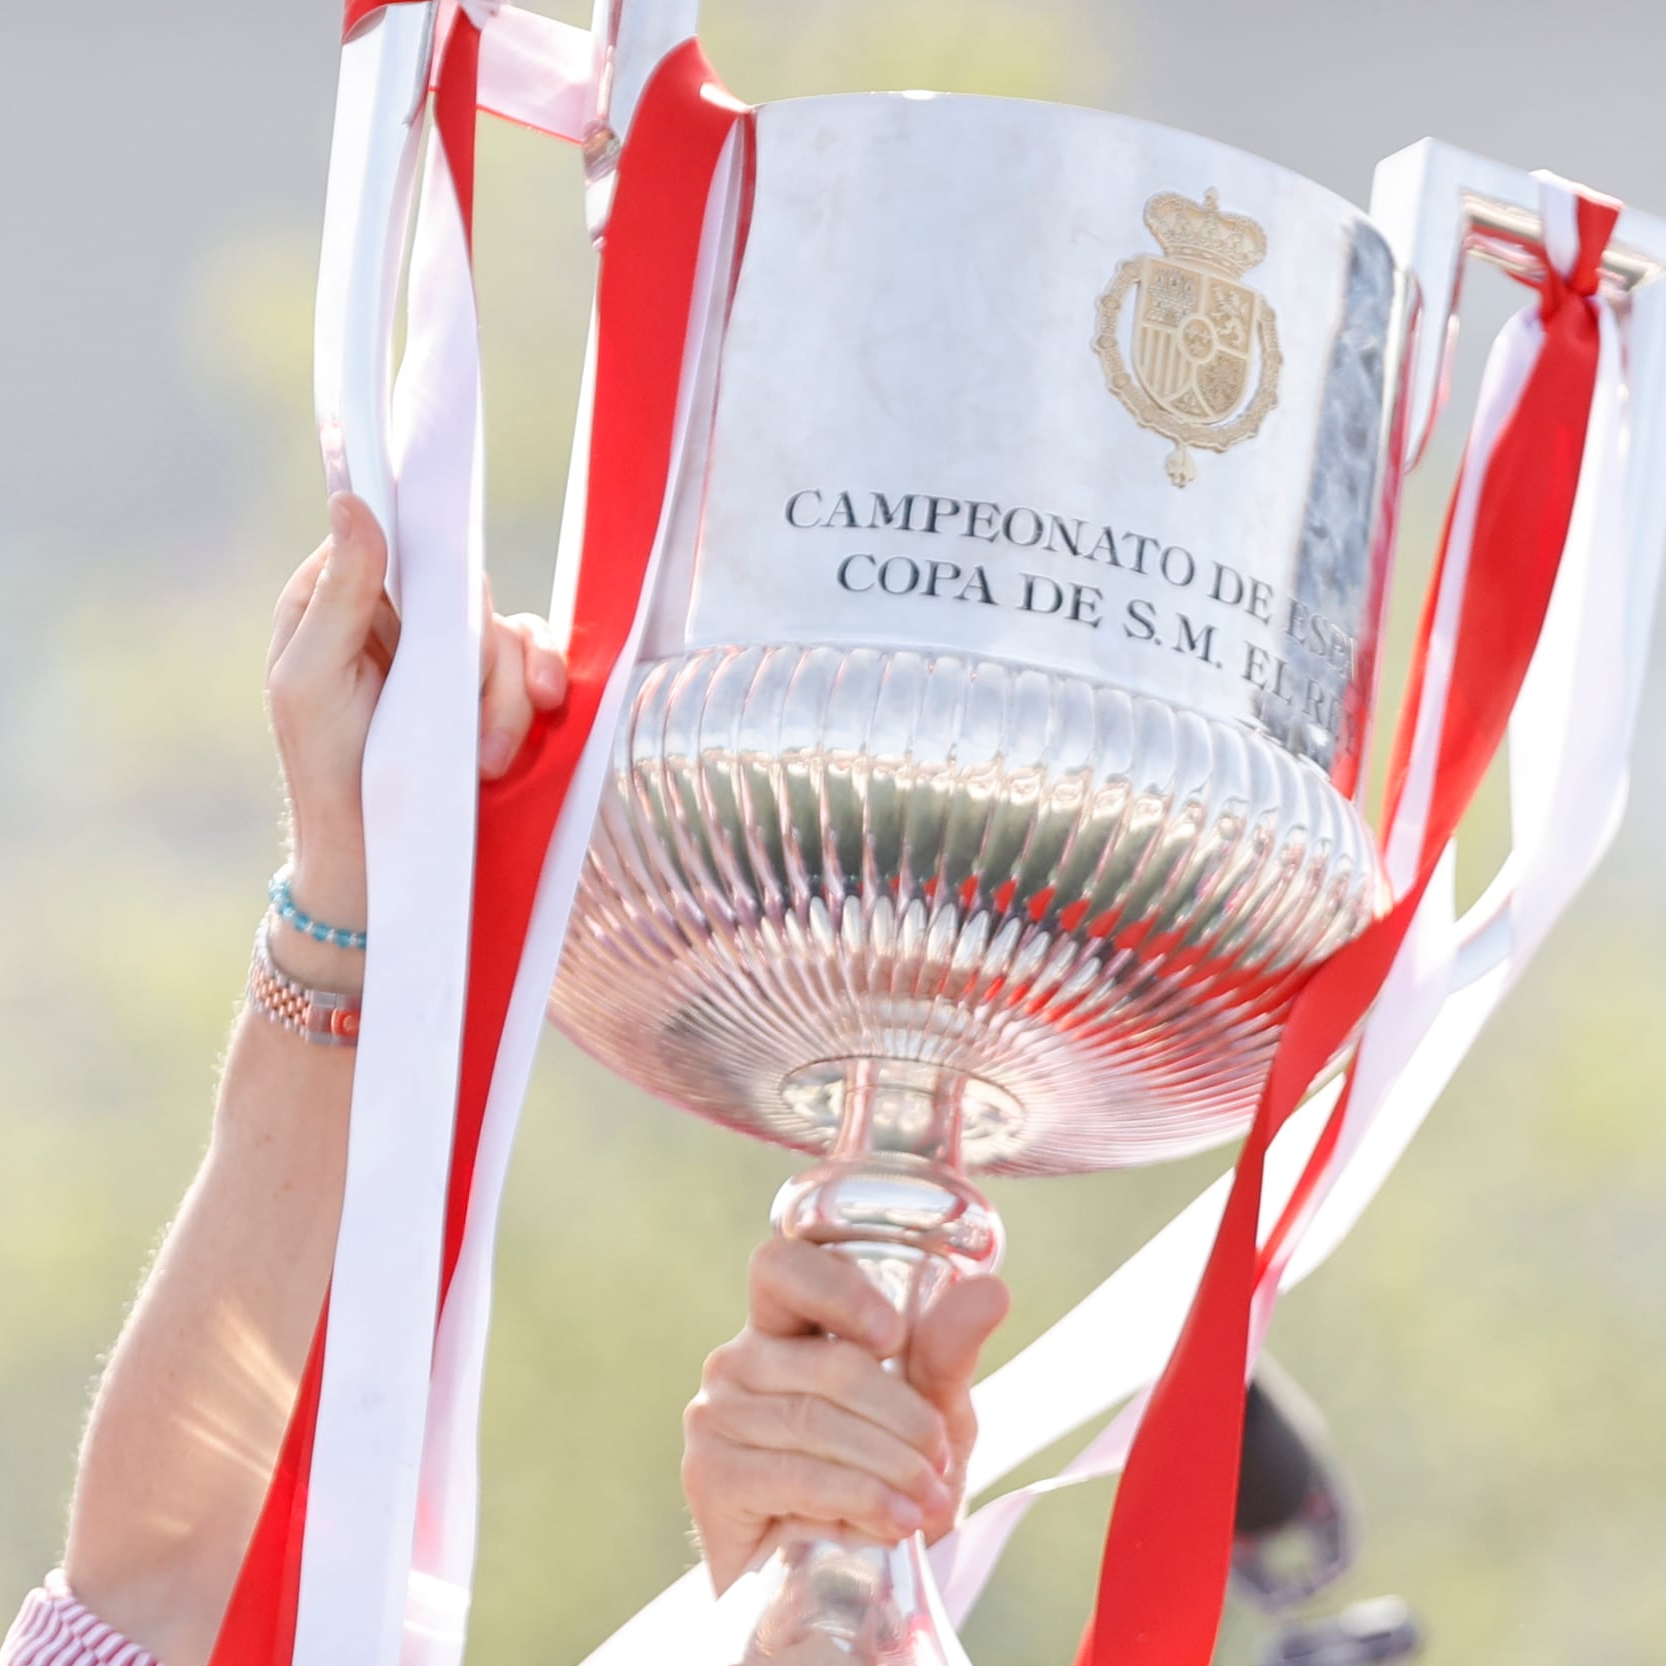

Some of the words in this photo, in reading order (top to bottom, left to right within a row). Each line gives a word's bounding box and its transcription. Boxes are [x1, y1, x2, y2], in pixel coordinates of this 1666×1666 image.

[784, 488, 1196, 587] CAMPEONATO
[1206, 560, 1275, 625] DE
[836, 553, 1000, 606] COPA
[1016, 572, 1104, 629] DE
[1240, 640, 1292, 706] EL
